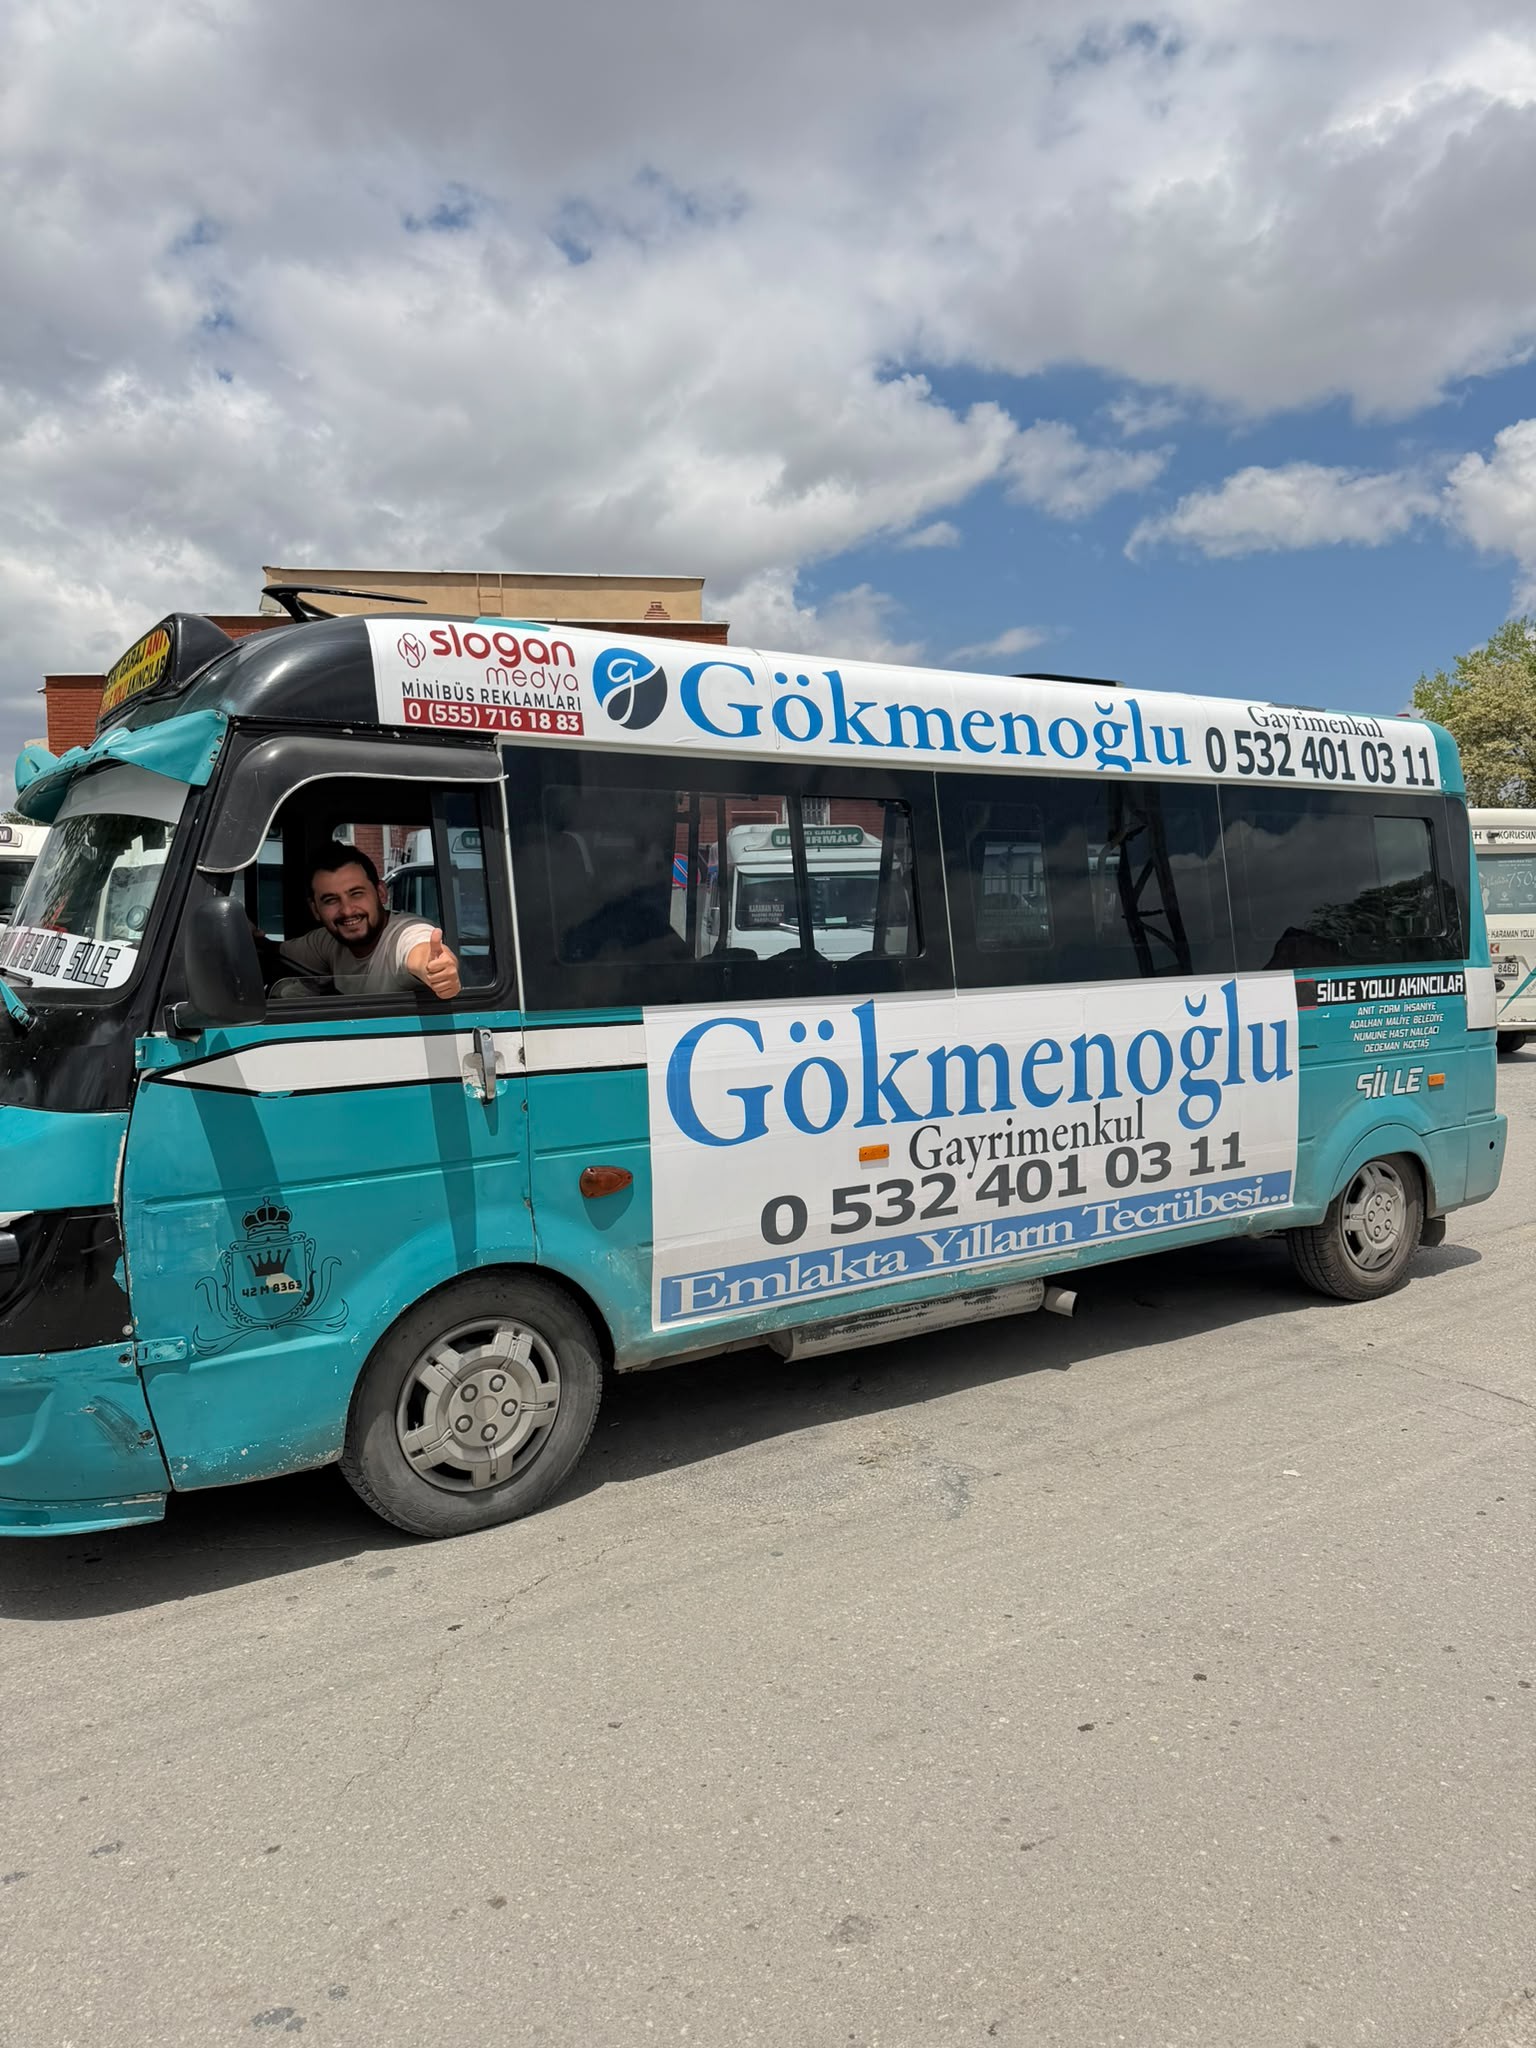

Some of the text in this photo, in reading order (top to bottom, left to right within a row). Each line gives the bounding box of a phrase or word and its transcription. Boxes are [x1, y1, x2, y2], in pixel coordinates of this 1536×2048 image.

[429, 624, 576, 668] slogan
[401, 677, 582, 711] MİNİBÜS REKLAMLARI
[485, 666, 580, 695] medya
[408, 702, 580, 732] 0 (555) 716 18 83
[680, 661, 1192, 772] Gökmenoğlu
[1247, 705, 1385, 740] Gayrimenkul
[1204, 726, 1435, 786] 0 532 401 03 11
[1490, 928, 1535, 938] KARAMAN YOLU
[1497, 963, 1517, 973] 8462
[1317, 974, 1464, 1003] SİLLE YOLU AKINCILAR
[1349, 1011, 1445, 1030] ADALHAN MALİYE BELEDİYE
[1357, 1000, 1437, 1016] ANIT FORM İHSANİYE
[1353, 1026, 1440, 1042] NUMUNE HAST NALÇACI
[1363, 1038, 1430, 1053] DEDEMAN KOÇTAŞ
[666, 978, 1293, 1147] Gökmenoğlu
[909, 1097, 1146, 1179] Gayrimenkul
[760, 1131, 1246, 1245] 0 532 401 03 11
[671, 1176, 1288, 1318] Emlakta Yılların Tecrübesi...
[242, 1279, 303, 1297] 42 M 8363
